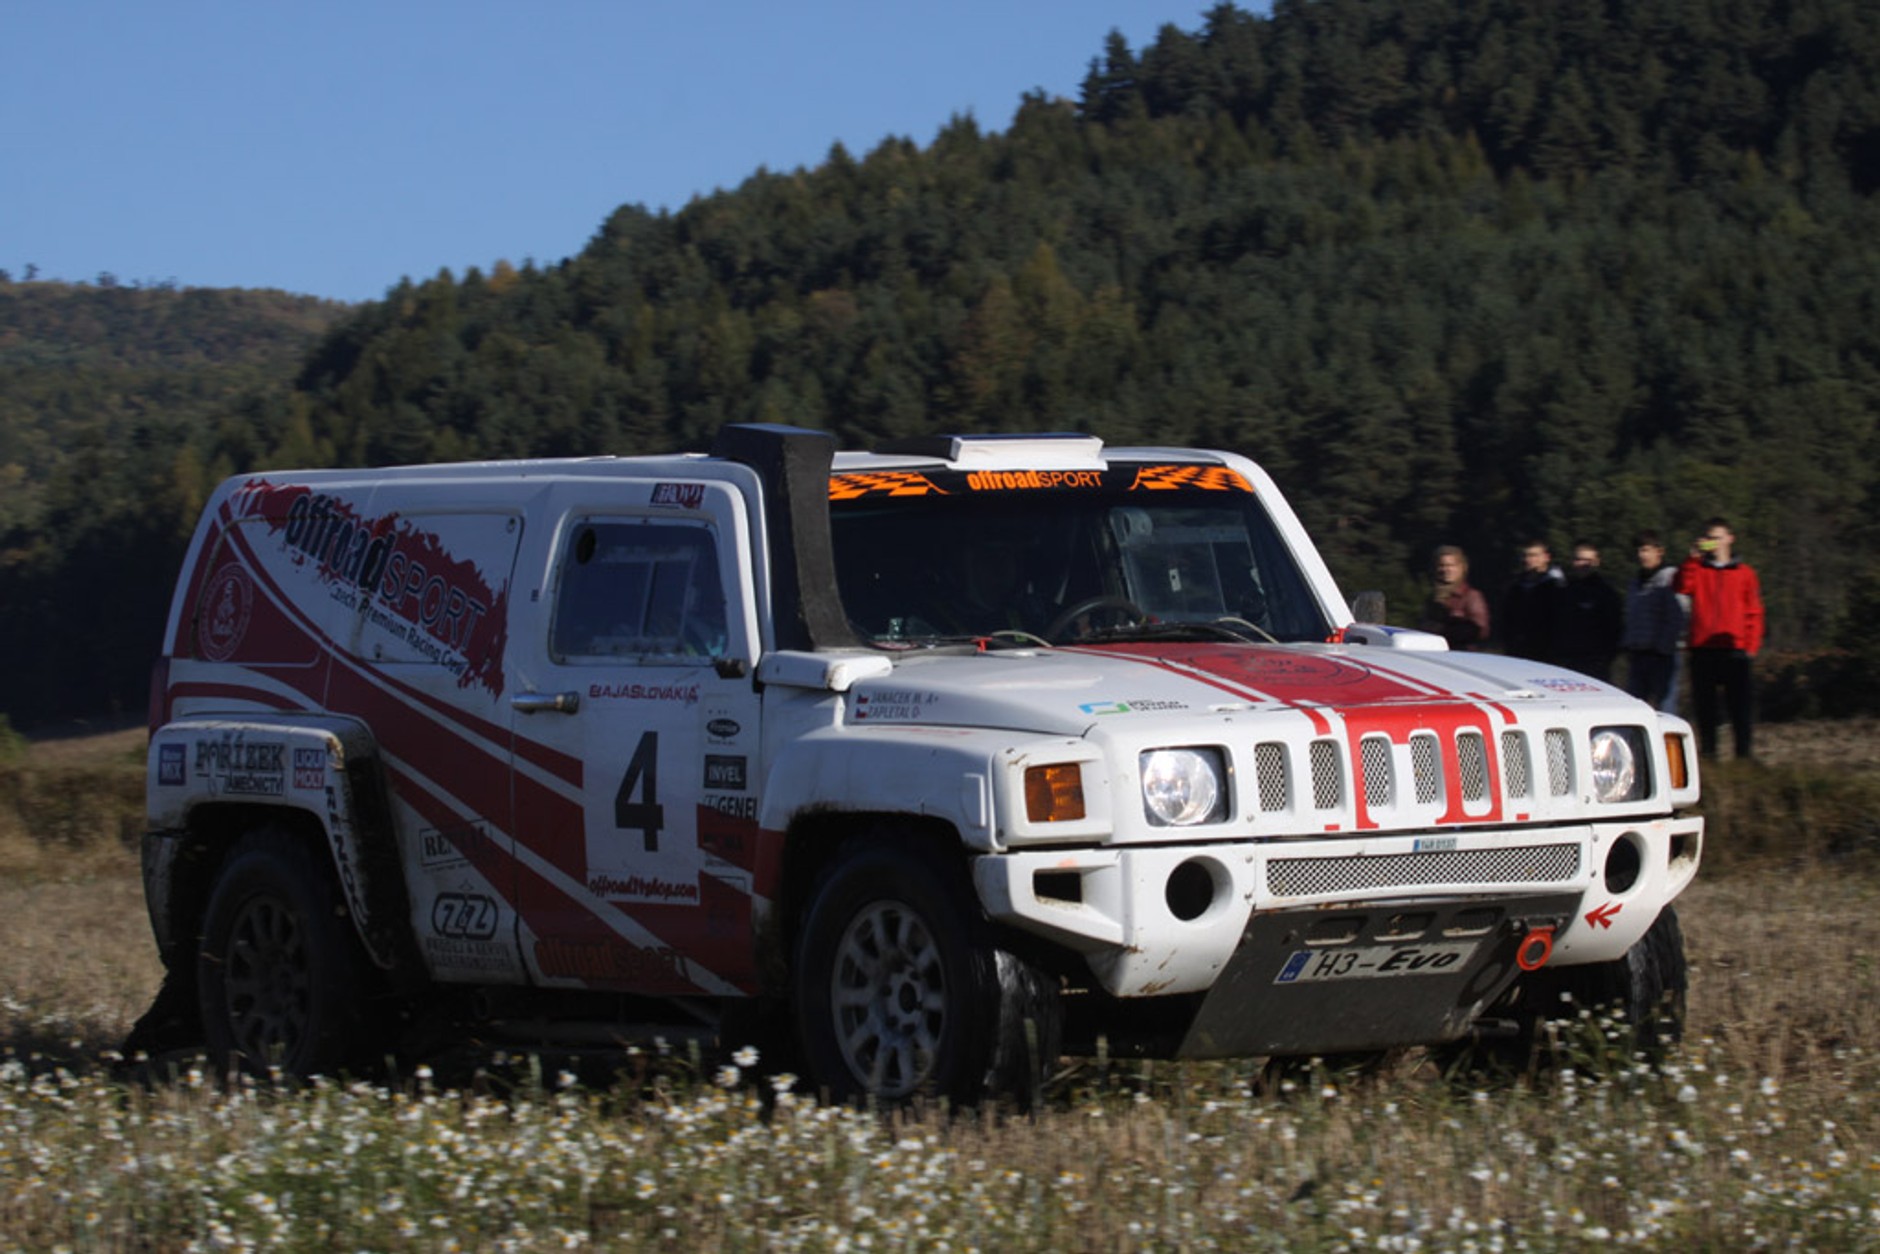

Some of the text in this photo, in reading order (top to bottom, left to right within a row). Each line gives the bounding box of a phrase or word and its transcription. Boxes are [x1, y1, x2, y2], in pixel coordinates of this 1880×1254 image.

[358, 595, 407, 640] Premium
[407, 628, 441, 663] Racing
[441, 649, 467, 677] Crew
[615, 731, 664, 852] 4
